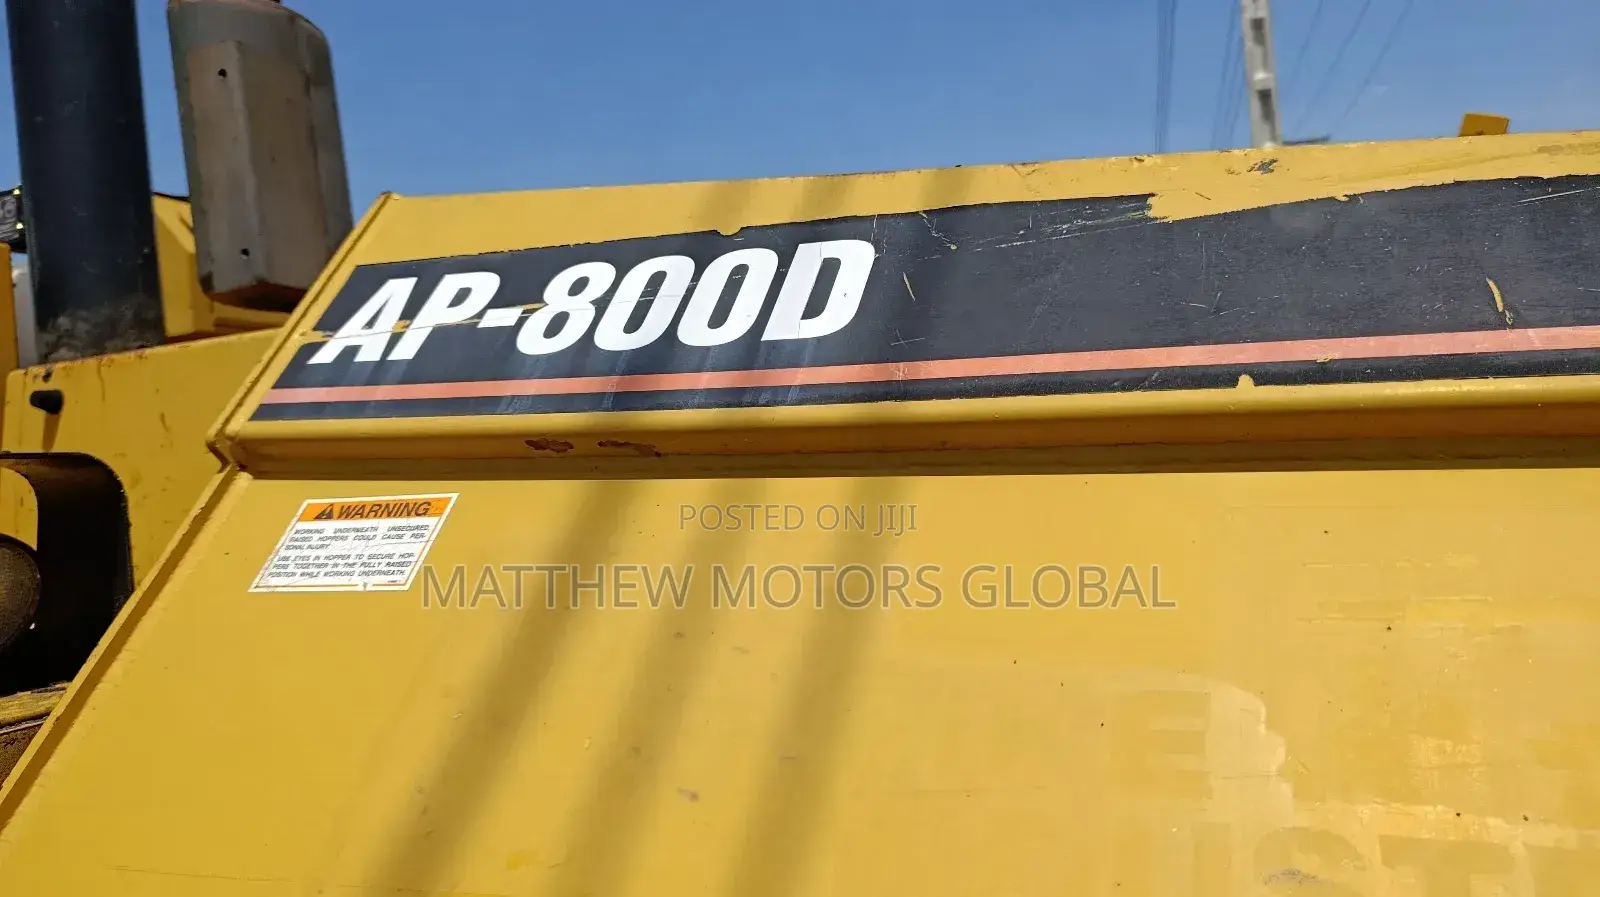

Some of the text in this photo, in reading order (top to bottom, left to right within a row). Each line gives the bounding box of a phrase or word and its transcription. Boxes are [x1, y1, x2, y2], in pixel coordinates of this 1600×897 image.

[306, 239, 877, 364] AP-800D
[337, 501, 432, 519] WARNING
[333, 526, 379, 534] UNDERNEATH
[324, 553, 351, 561] HOPPER
[367, 552, 395, 560] SECURE
[293, 562, 328, 570] TOGETHER
[385, 560, 412, 568] RAISED
